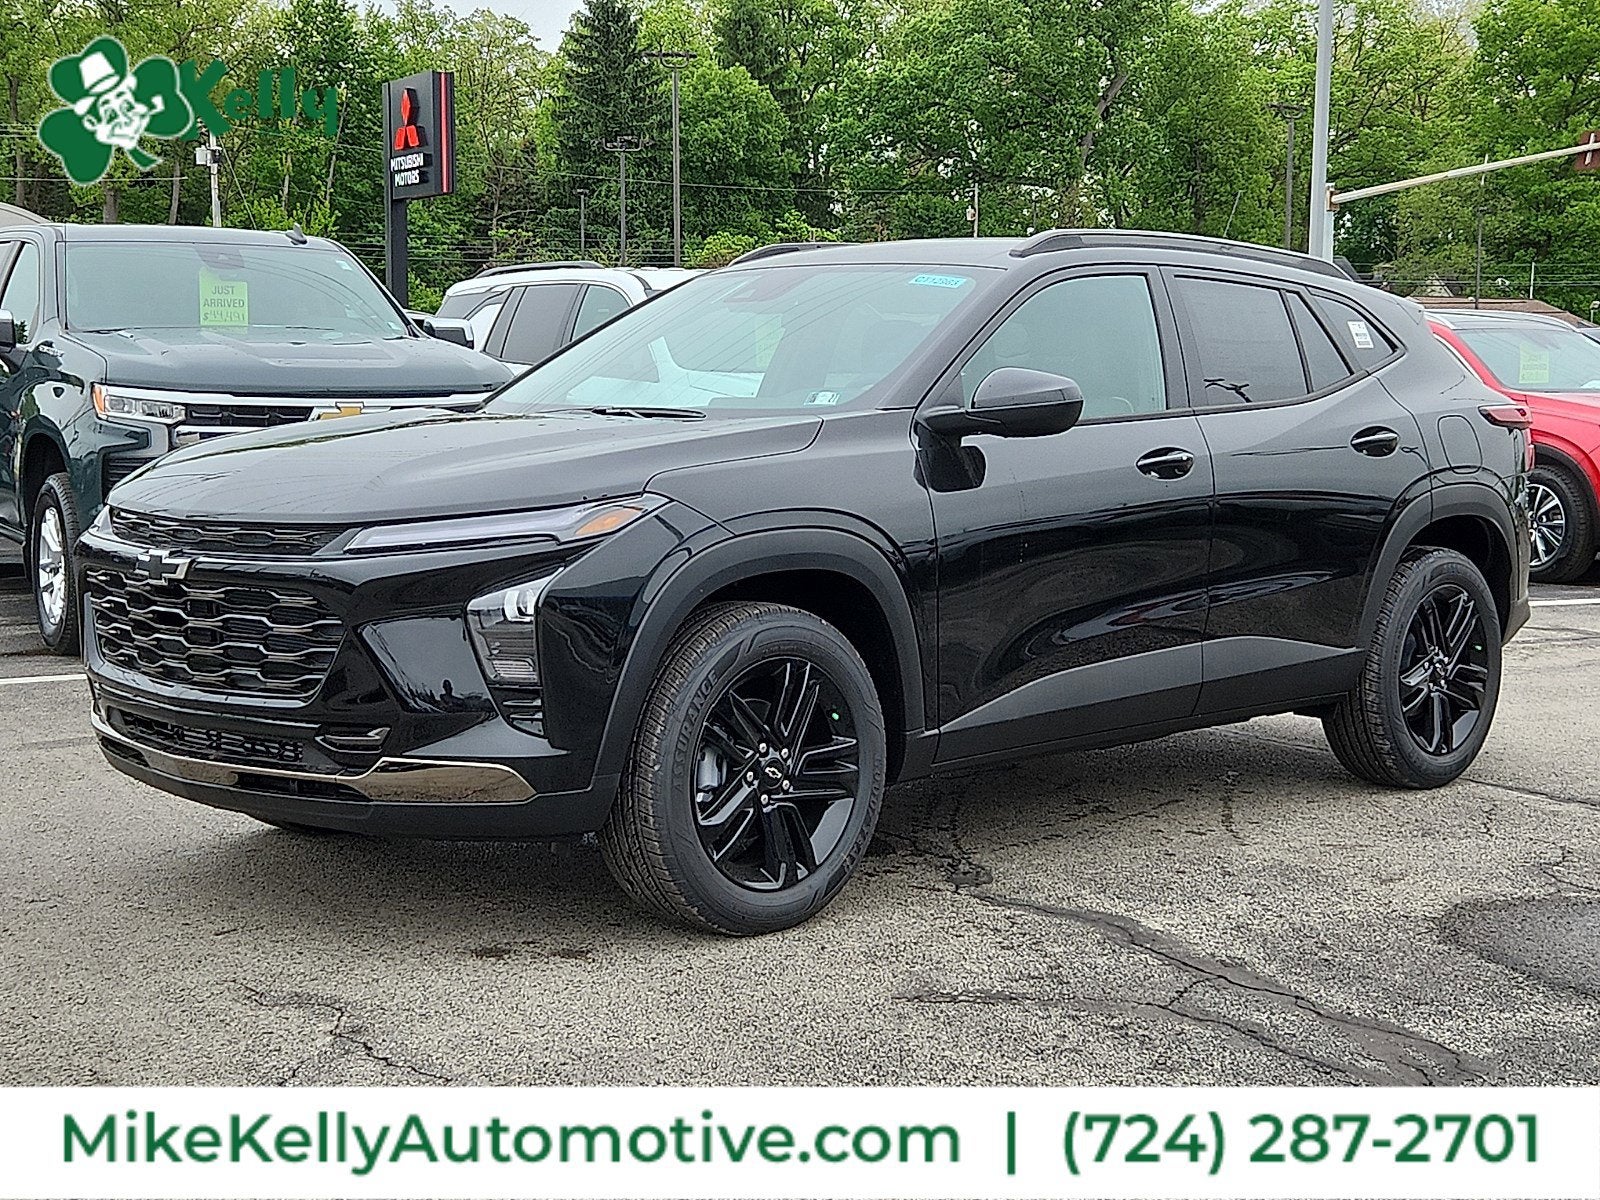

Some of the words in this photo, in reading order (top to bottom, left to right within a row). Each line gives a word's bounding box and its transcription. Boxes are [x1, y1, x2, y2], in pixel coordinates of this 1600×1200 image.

[390, 152, 424, 172] MITSUBISHI
[394, 169, 420, 187] MOTORS
[211, 285, 235, 295] JUST
[203, 298, 245, 308] ARRIVED
[673, 669, 718, 793] ASSURANCE
